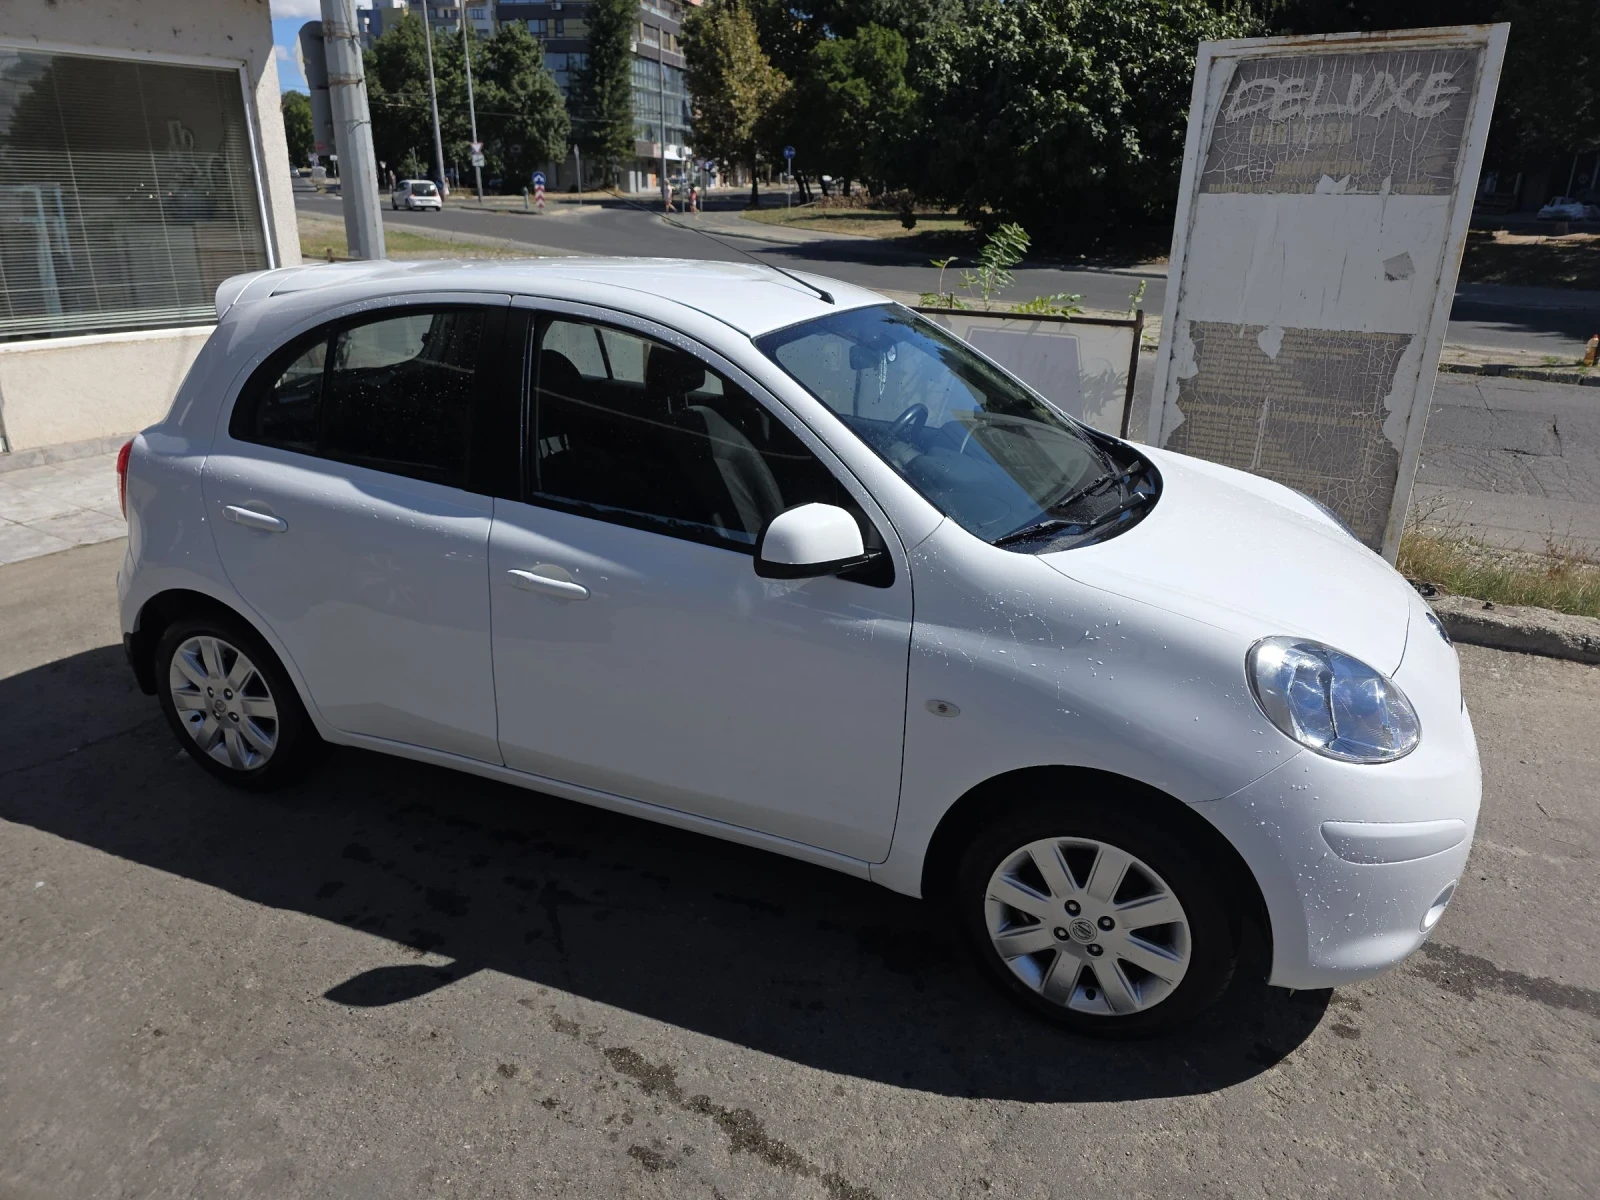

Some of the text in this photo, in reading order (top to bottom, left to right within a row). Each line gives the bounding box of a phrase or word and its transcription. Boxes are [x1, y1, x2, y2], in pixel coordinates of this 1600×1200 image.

[1225, 71, 1461, 123] DELUXE
[1252, 123, 1353, 144] CAR WASH
